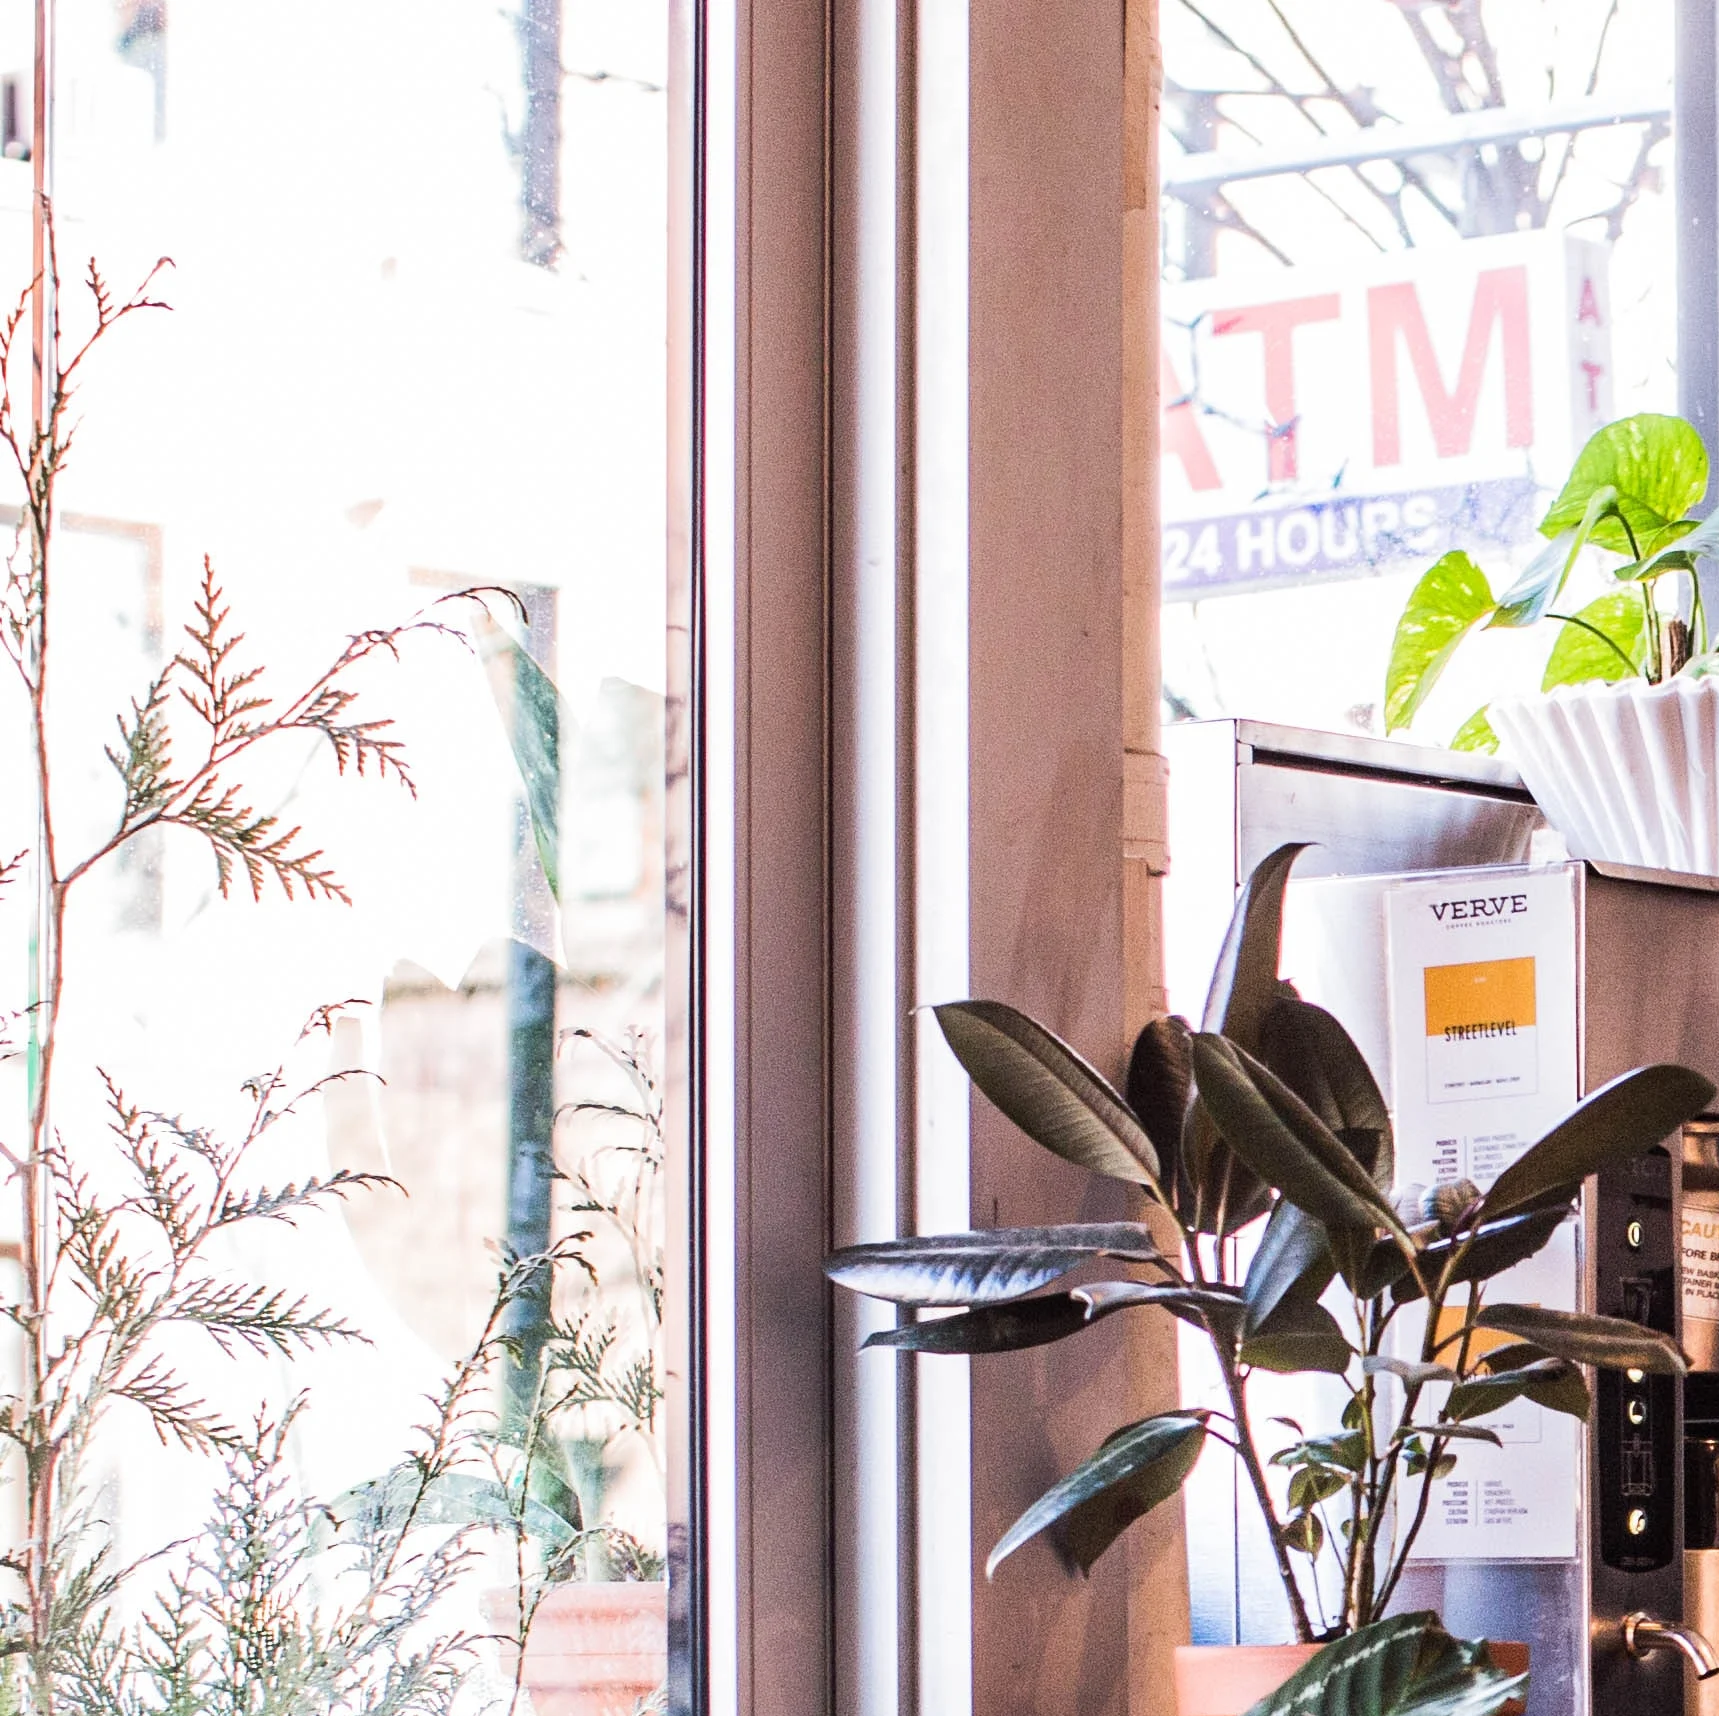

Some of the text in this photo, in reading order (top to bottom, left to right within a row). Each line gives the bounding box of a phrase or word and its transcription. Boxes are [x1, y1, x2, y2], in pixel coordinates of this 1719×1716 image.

[1577, 277, 1604, 412] AT
[1164, 500, 1438, 580] 24 HOURS
[1429, 894, 1528, 922] VERVE
[1444, 1020, 1518, 1043] STREETLEVEL
[1682, 1247, 1707, 1260] FORE
[1682, 1266, 1695, 1275] EW
[1682, 1277, 1712, 1288] TAINER
[1685, 1287, 1694, 1296] IN
